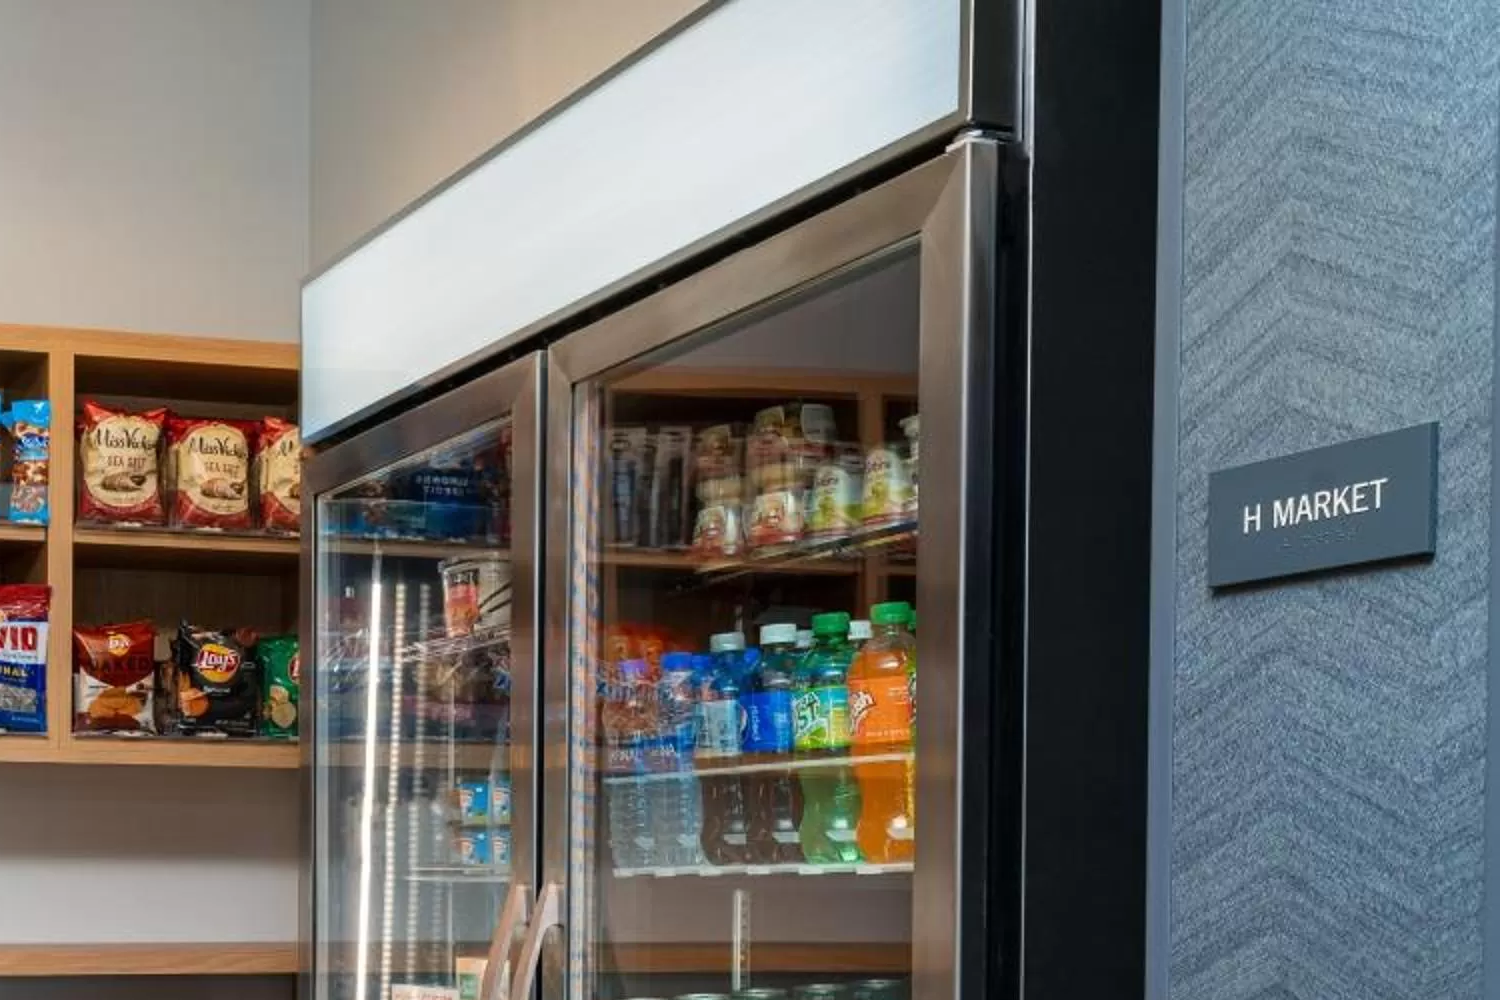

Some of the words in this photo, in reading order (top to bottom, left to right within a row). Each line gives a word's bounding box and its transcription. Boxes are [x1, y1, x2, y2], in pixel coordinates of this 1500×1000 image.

[107, 455, 125, 467] SEA
[1242, 503, 1262, 535] H
[1272, 477, 1389, 529] MARKET
[199, 653, 237, 671] Lay's
